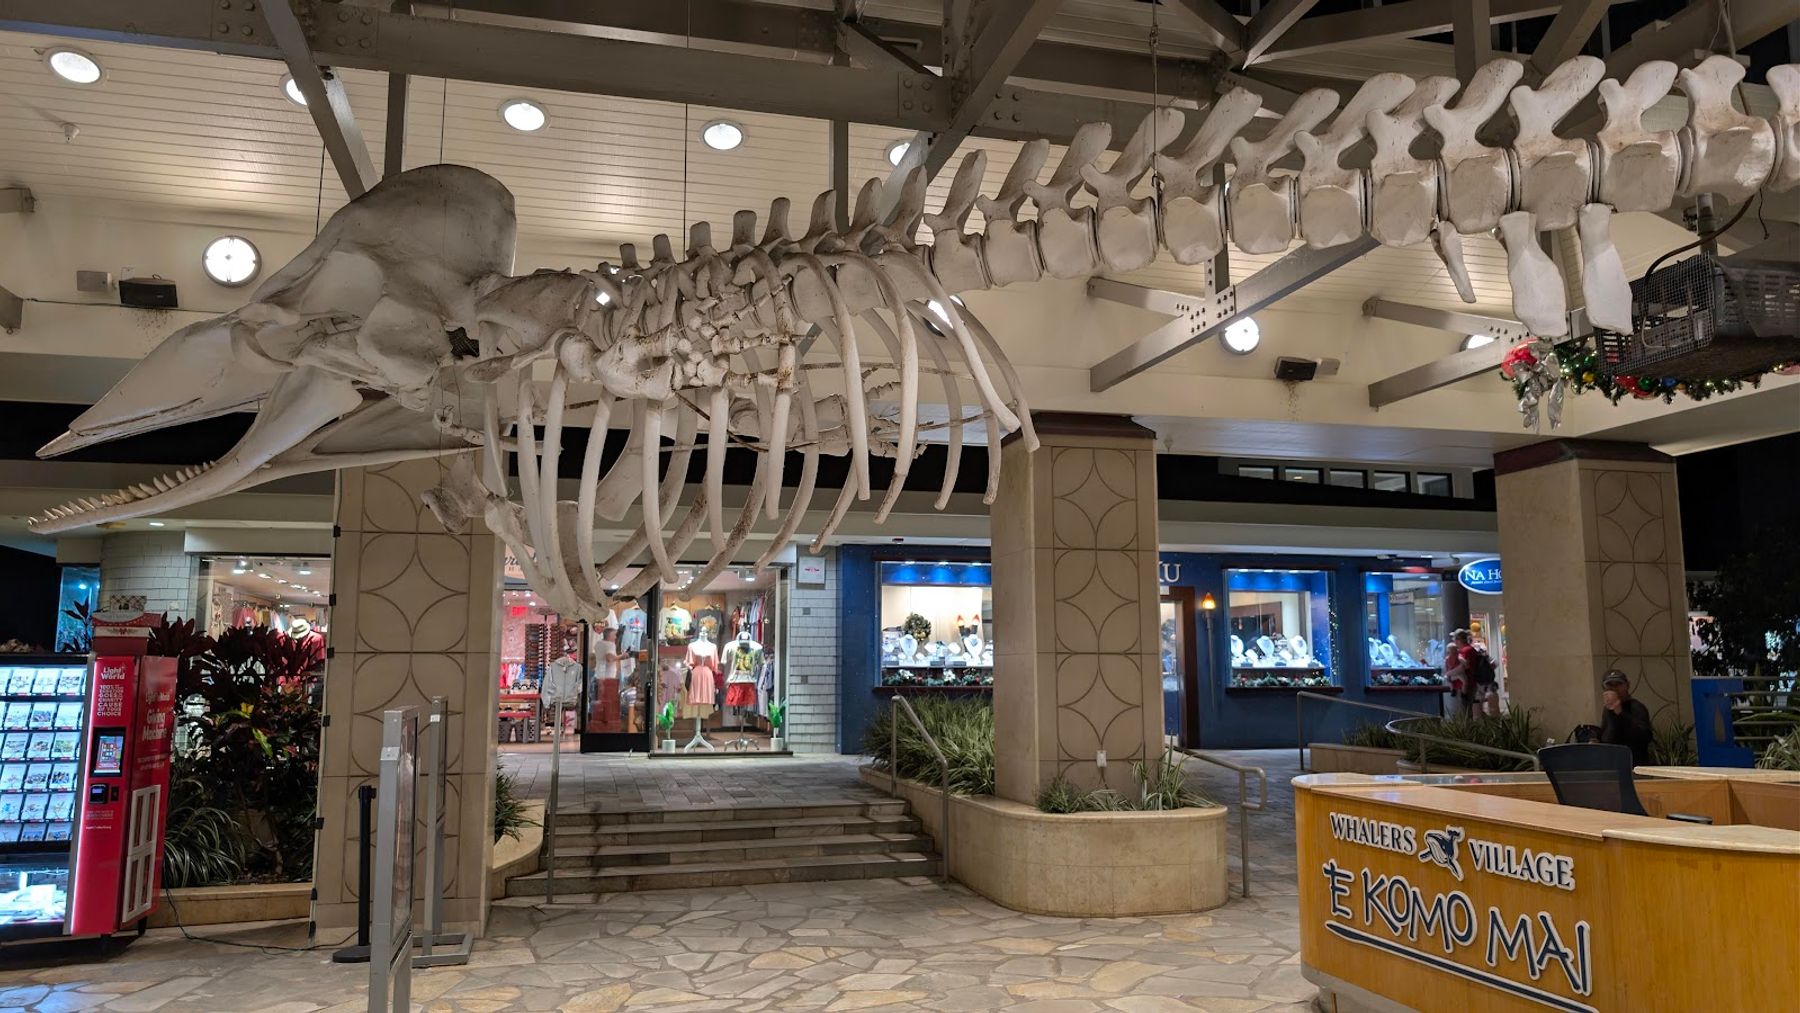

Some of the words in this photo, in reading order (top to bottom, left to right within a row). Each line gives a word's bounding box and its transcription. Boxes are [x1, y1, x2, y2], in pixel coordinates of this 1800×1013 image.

[1329, 812, 1417, 855] WHALERS
[1468, 838, 1575, 890] VILLAGE
[1361, 867, 1478, 953] KOMO
[1486, 906, 1593, 996] MAI
